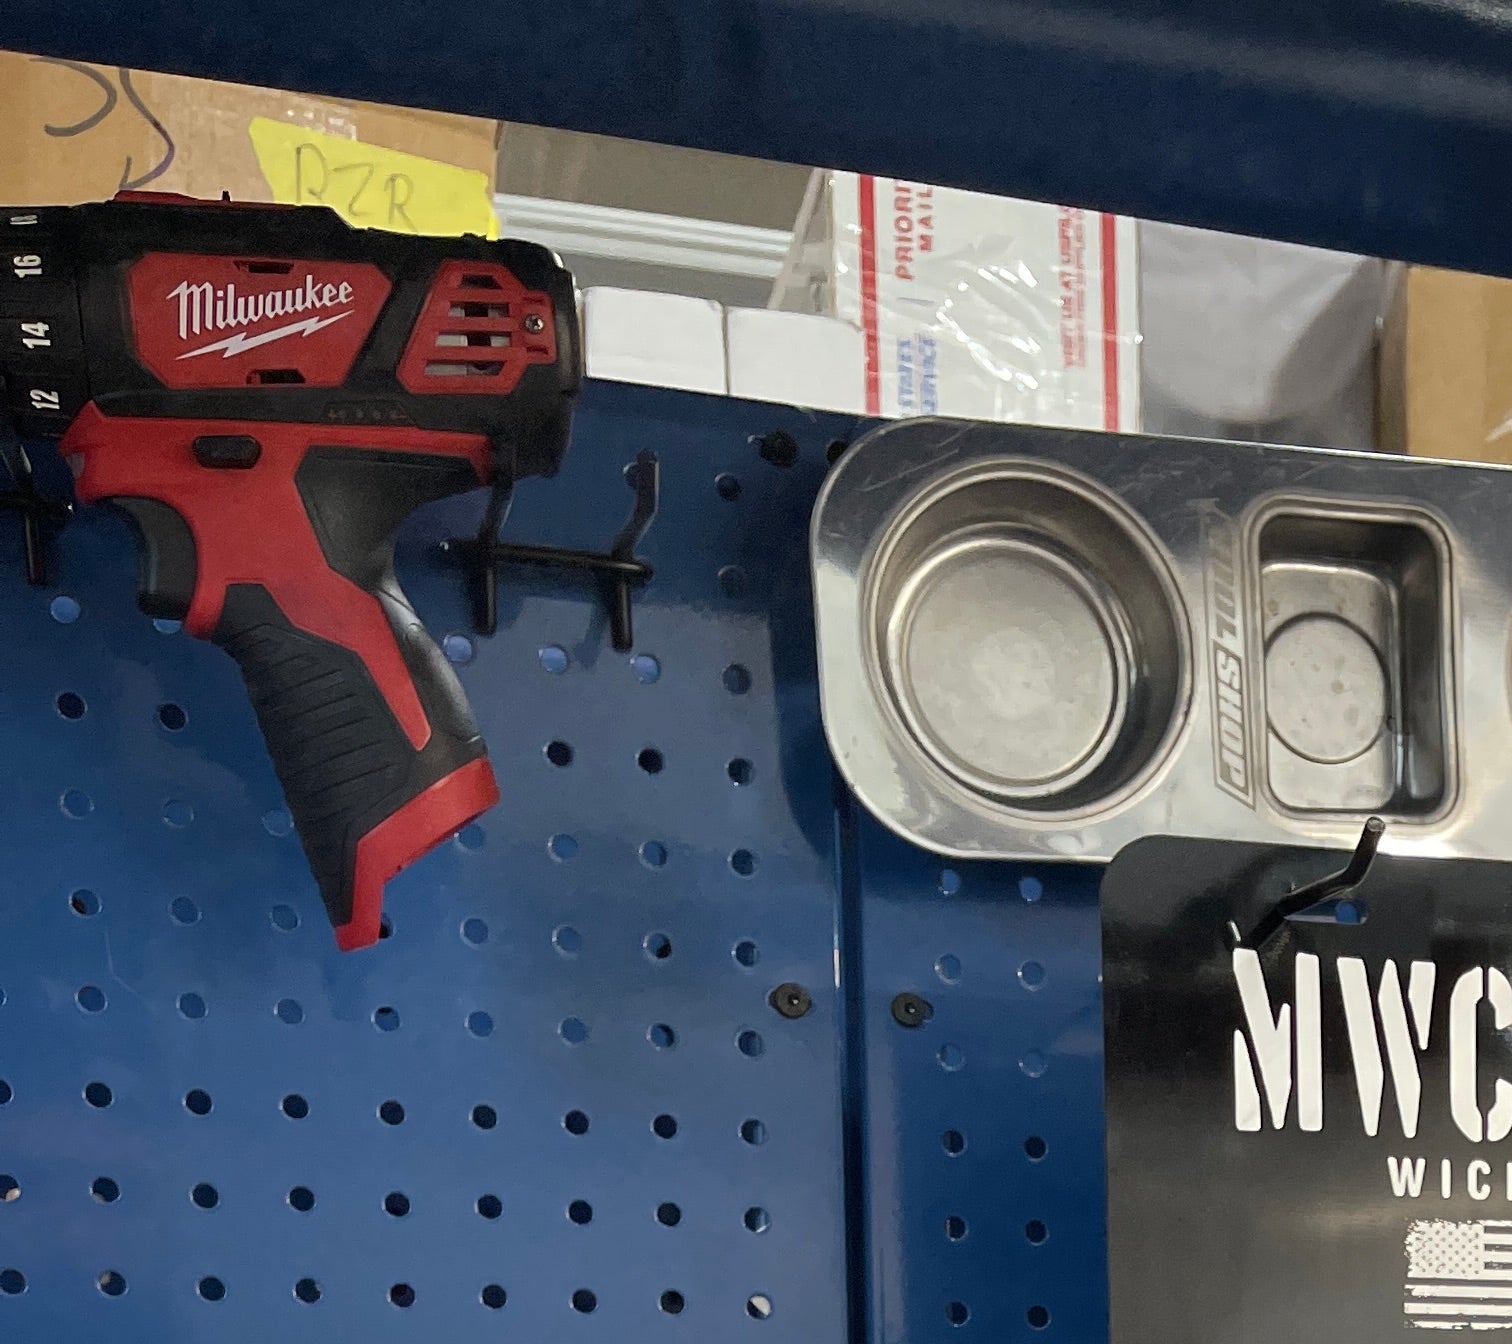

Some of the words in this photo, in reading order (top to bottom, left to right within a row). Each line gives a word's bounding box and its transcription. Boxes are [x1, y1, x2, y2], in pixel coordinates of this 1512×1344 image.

[894, 180, 914, 282] PRIORI
[916, 186, 934, 253] MAIL
[13, 253, 43, 280] 16
[21, 321, 51, 350] 14
[166, 274, 356, 340] Milwaukee
[30, 388, 61, 410] 12
[1215, 647, 1248, 790] SHOP
